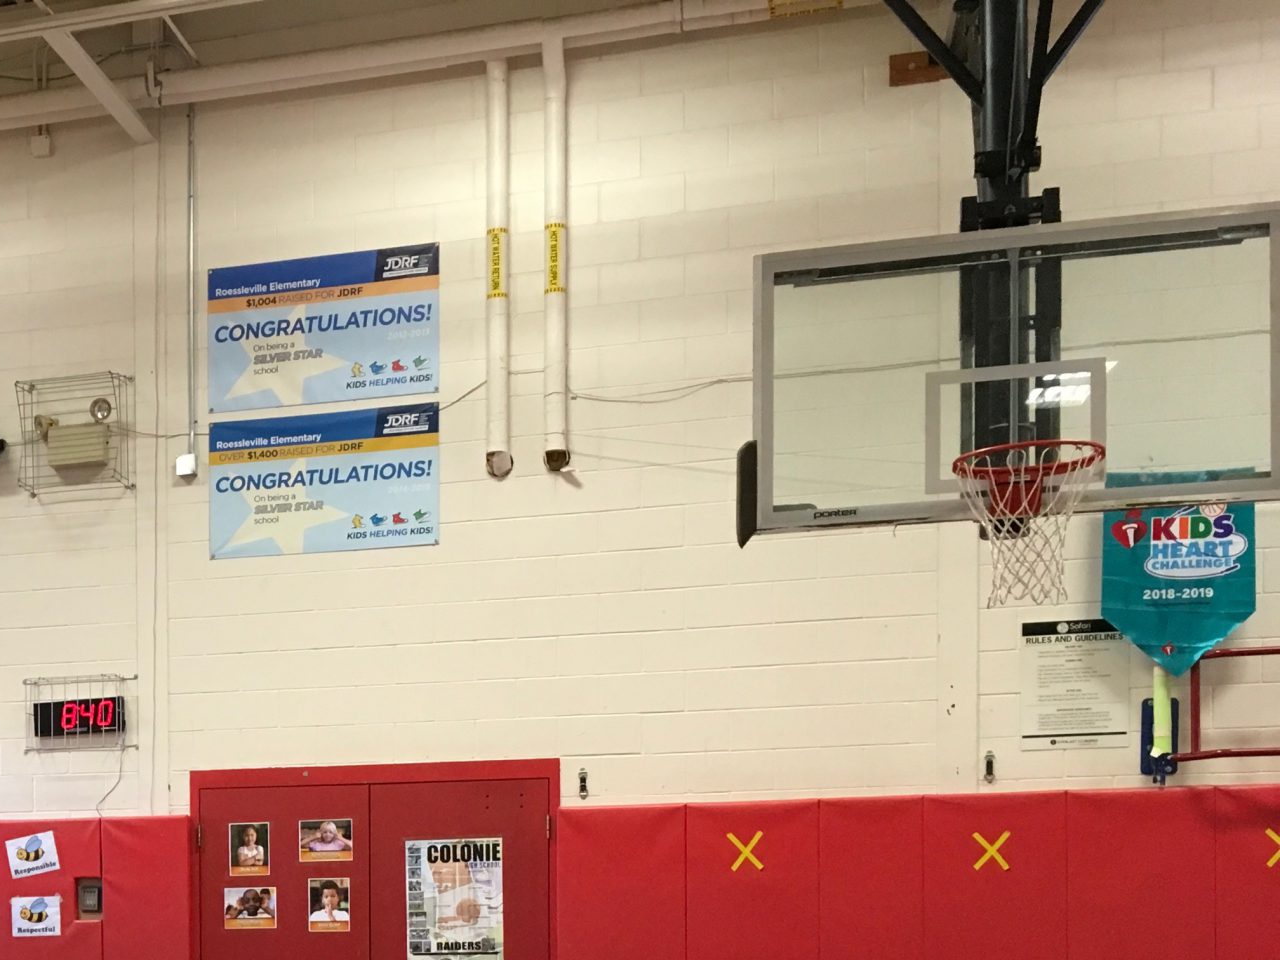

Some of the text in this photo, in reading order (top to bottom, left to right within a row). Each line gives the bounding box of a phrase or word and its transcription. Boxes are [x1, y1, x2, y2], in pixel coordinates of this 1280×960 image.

[383, 255, 419, 270] JDRF
[215, 278, 321, 297] Roessleville Elementary
[246, 287, 363, 308] $1,004 RAISED FOR JDRF
[214, 304, 432, 343] CONGRATULATIONS!
[253, 343, 264, 352] On
[266, 342, 286, 353] being
[253, 348, 323, 365] SILVER STAR
[253, 365, 279, 375] school
[346, 374, 433, 390] KIDS HELPING KIDS!
[383, 414, 419, 427] JDRF
[216, 433, 322, 449] Roessleville Elementary
[219, 442, 364, 462] OVER $1,400 RAISED FOR JDRF
[215, 460, 432, 494] CONGRATULATIONS!
[254, 495, 265, 503] On
[267, 493, 286, 504] being
[254, 500, 324, 514] SILVER STAR
[254, 516, 279, 525] school
[1152, 514, 1234, 541] KIDS
[347, 526, 434, 540] KIDS HELPING KIDS!
[1152, 540, 1233, 560] HEART
[1151, 558, 1233, 570] CHALLENGE
[1142, 588, 1214, 600] 2018-2019
[1026, 632, 1124, 644] RULES AND GUIDELINES
[426, 842, 502, 864] COLONIE
[13, 861, 57, 876] Responsible
[16, 926, 56, 934] Respectful
[436, 941, 482, 951] RAIDERS
